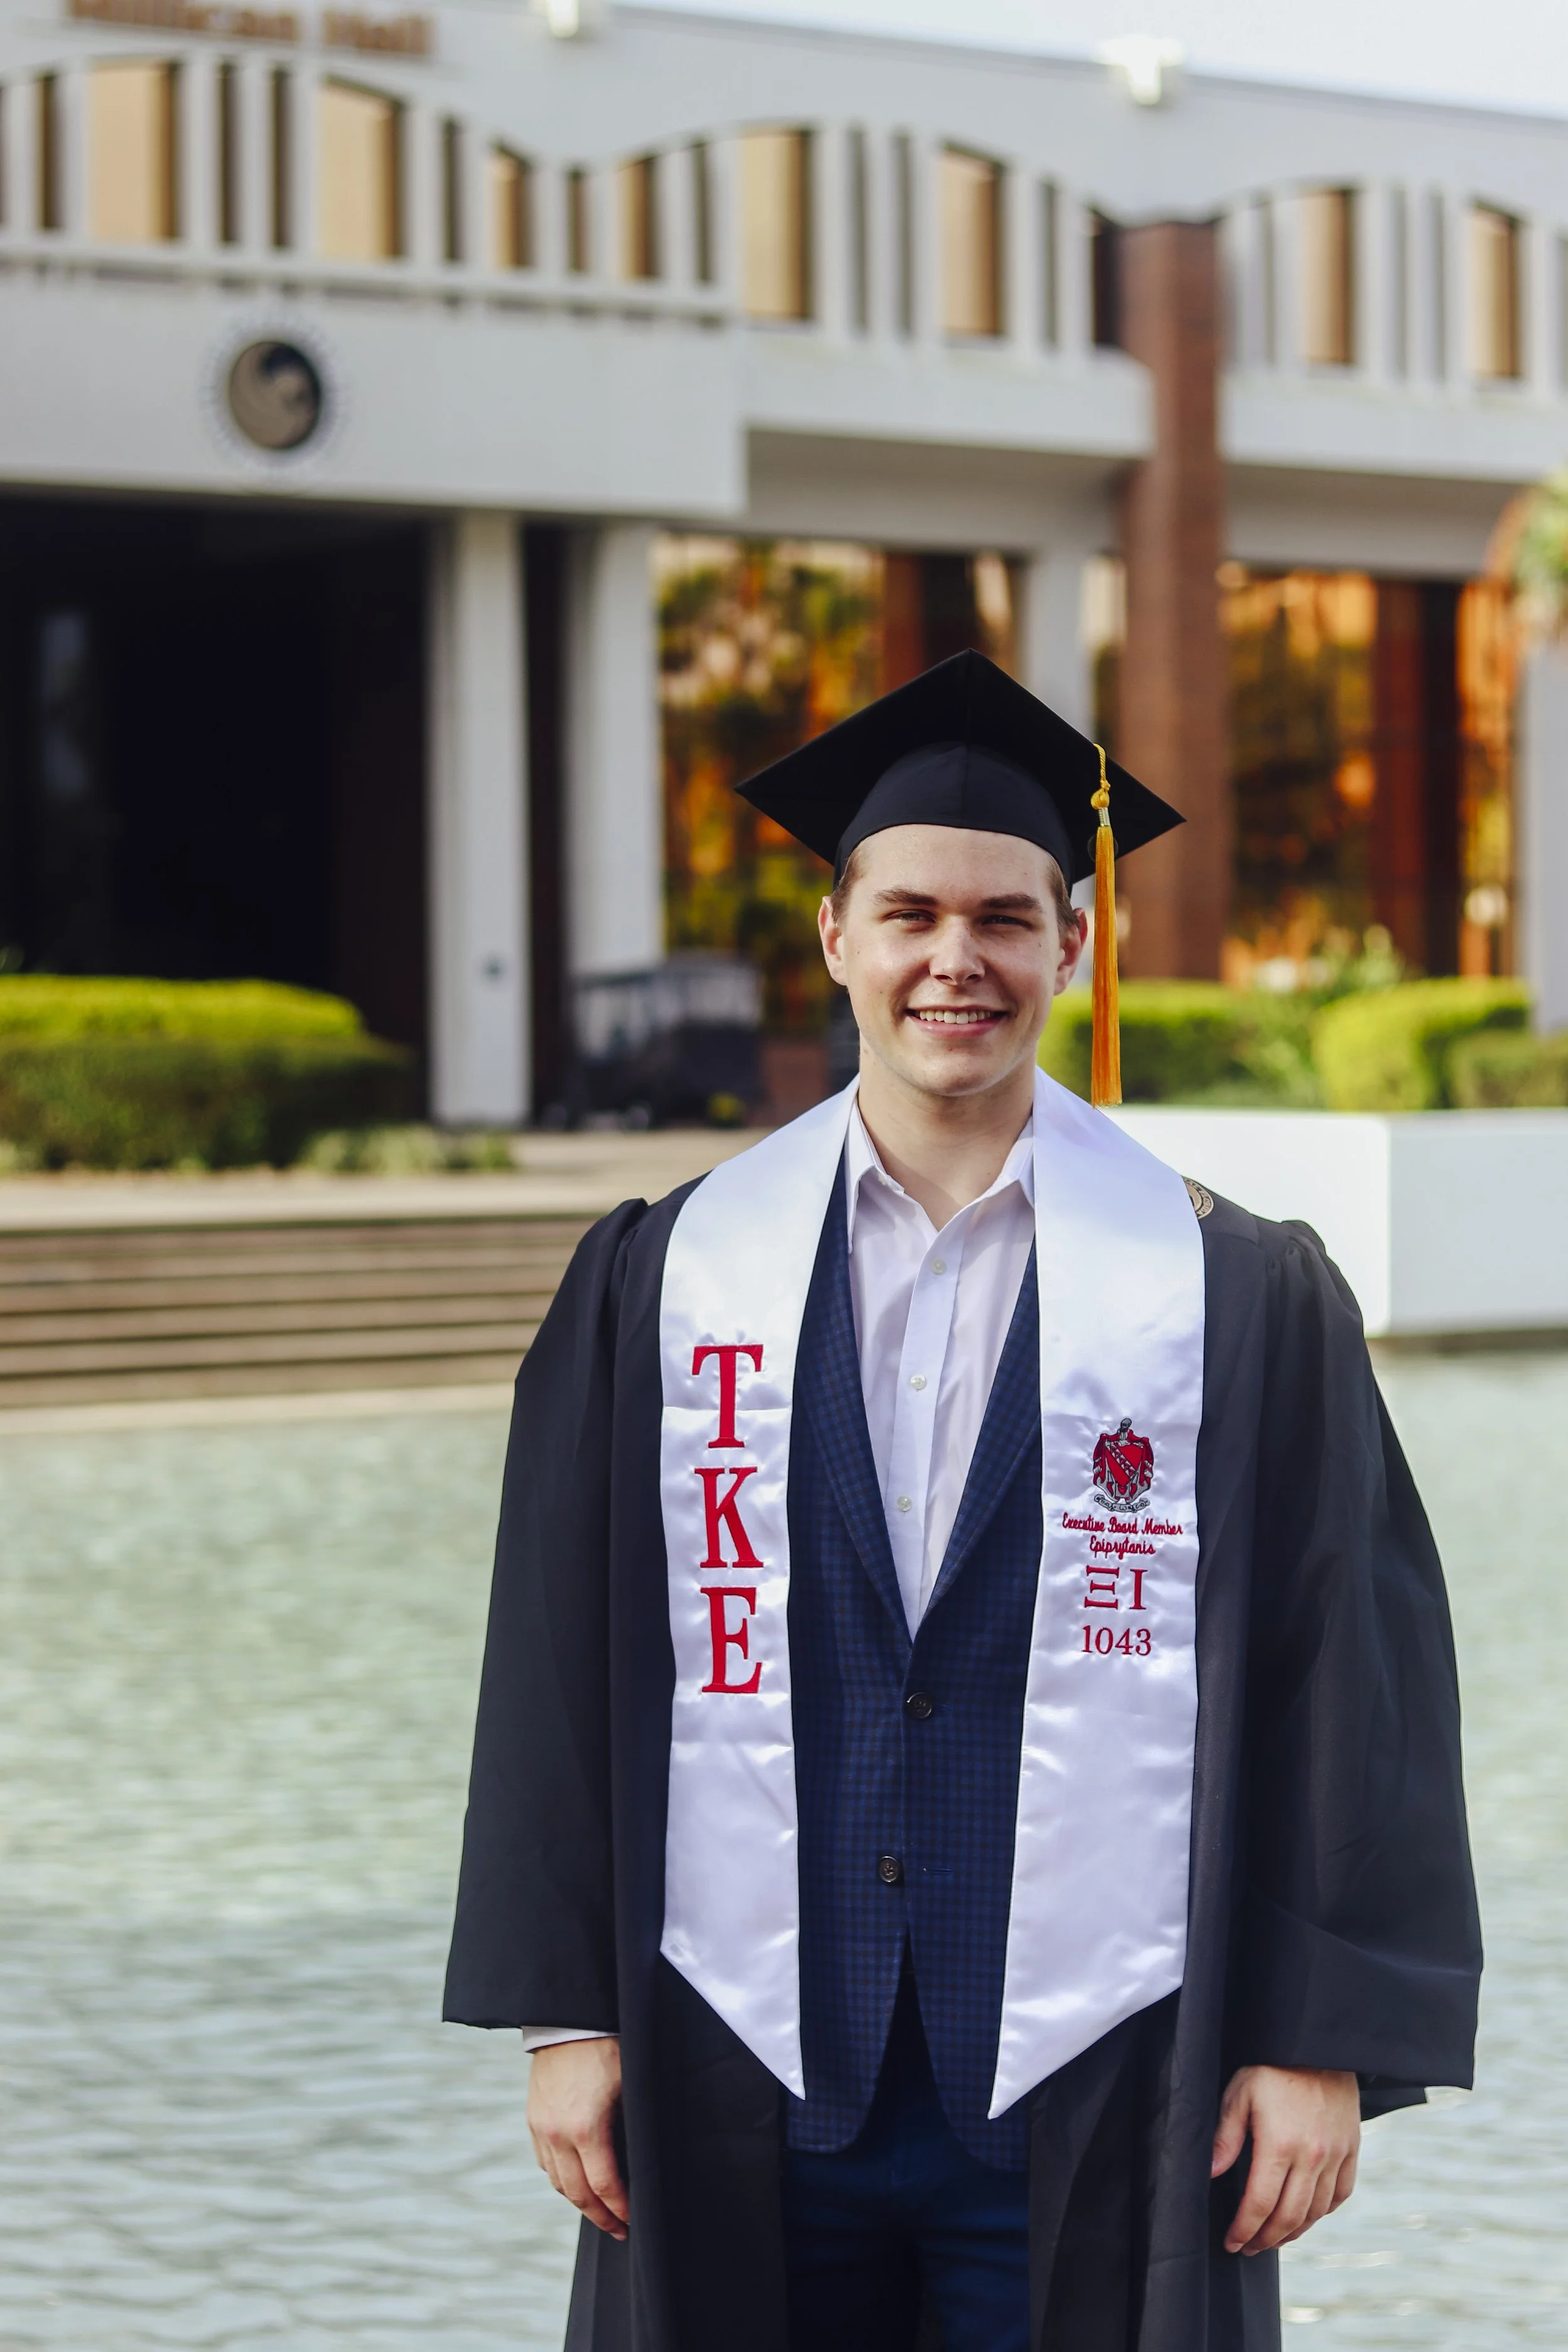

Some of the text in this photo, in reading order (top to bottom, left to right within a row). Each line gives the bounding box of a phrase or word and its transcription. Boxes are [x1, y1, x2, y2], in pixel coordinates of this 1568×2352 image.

[1062, 1513, 1183, 1535] Executive Board Member
[1090, 1535, 1155, 1560] Epiprytanis
[1081, 1625, 1152, 1656] 1043
